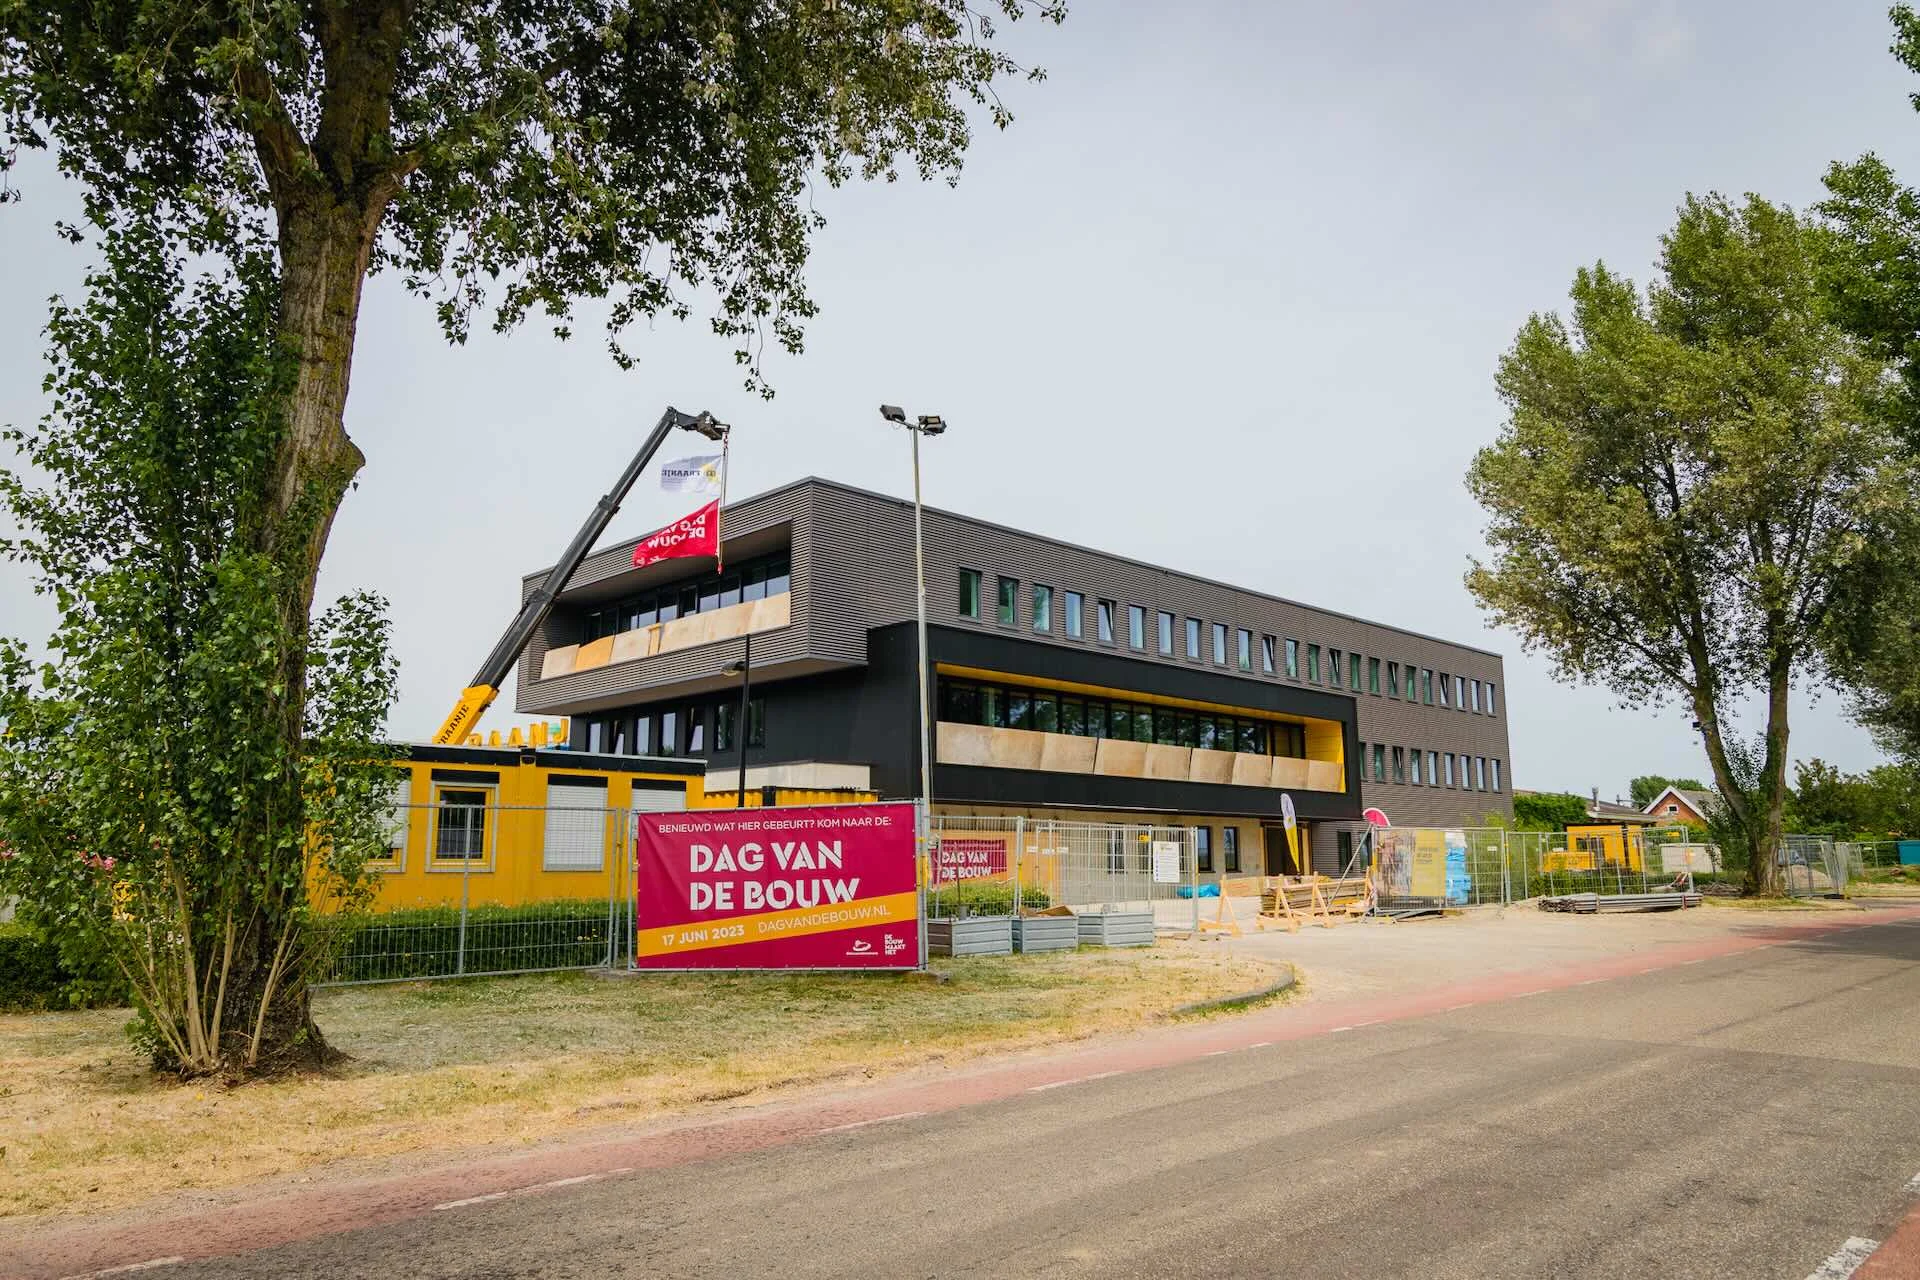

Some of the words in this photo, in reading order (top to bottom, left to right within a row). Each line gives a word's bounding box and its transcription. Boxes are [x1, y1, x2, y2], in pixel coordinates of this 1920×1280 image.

[437, 703, 469, 745] RAANJE
[659, 822, 711, 833] BENIEUWD
[714, 822, 735, 831] WAT
[738, 821, 760, 830] HIER
[762, 819, 815, 830] GEBEURT?
[817, 818, 840, 828] KOM
[843, 817, 872, 827] NAAR
[875, 816, 892, 826] DE:
[690, 842, 764, 873] DAG
[771, 840, 842, 871] VAN
[942, 852, 966, 863] DAG
[966, 852, 988, 863] VAN
[942, 867, 956, 878] DE
[958, 866, 992, 878] BOUW
[690, 881, 735, 911] DE
[743, 877, 860, 910] BOUW
[662, 935, 674, 946] 17
[679, 929, 708, 944] JUNI
[712, 925, 745, 940] 2023
[758, 905, 890, 933] DAGVANDEBOUW.NL
